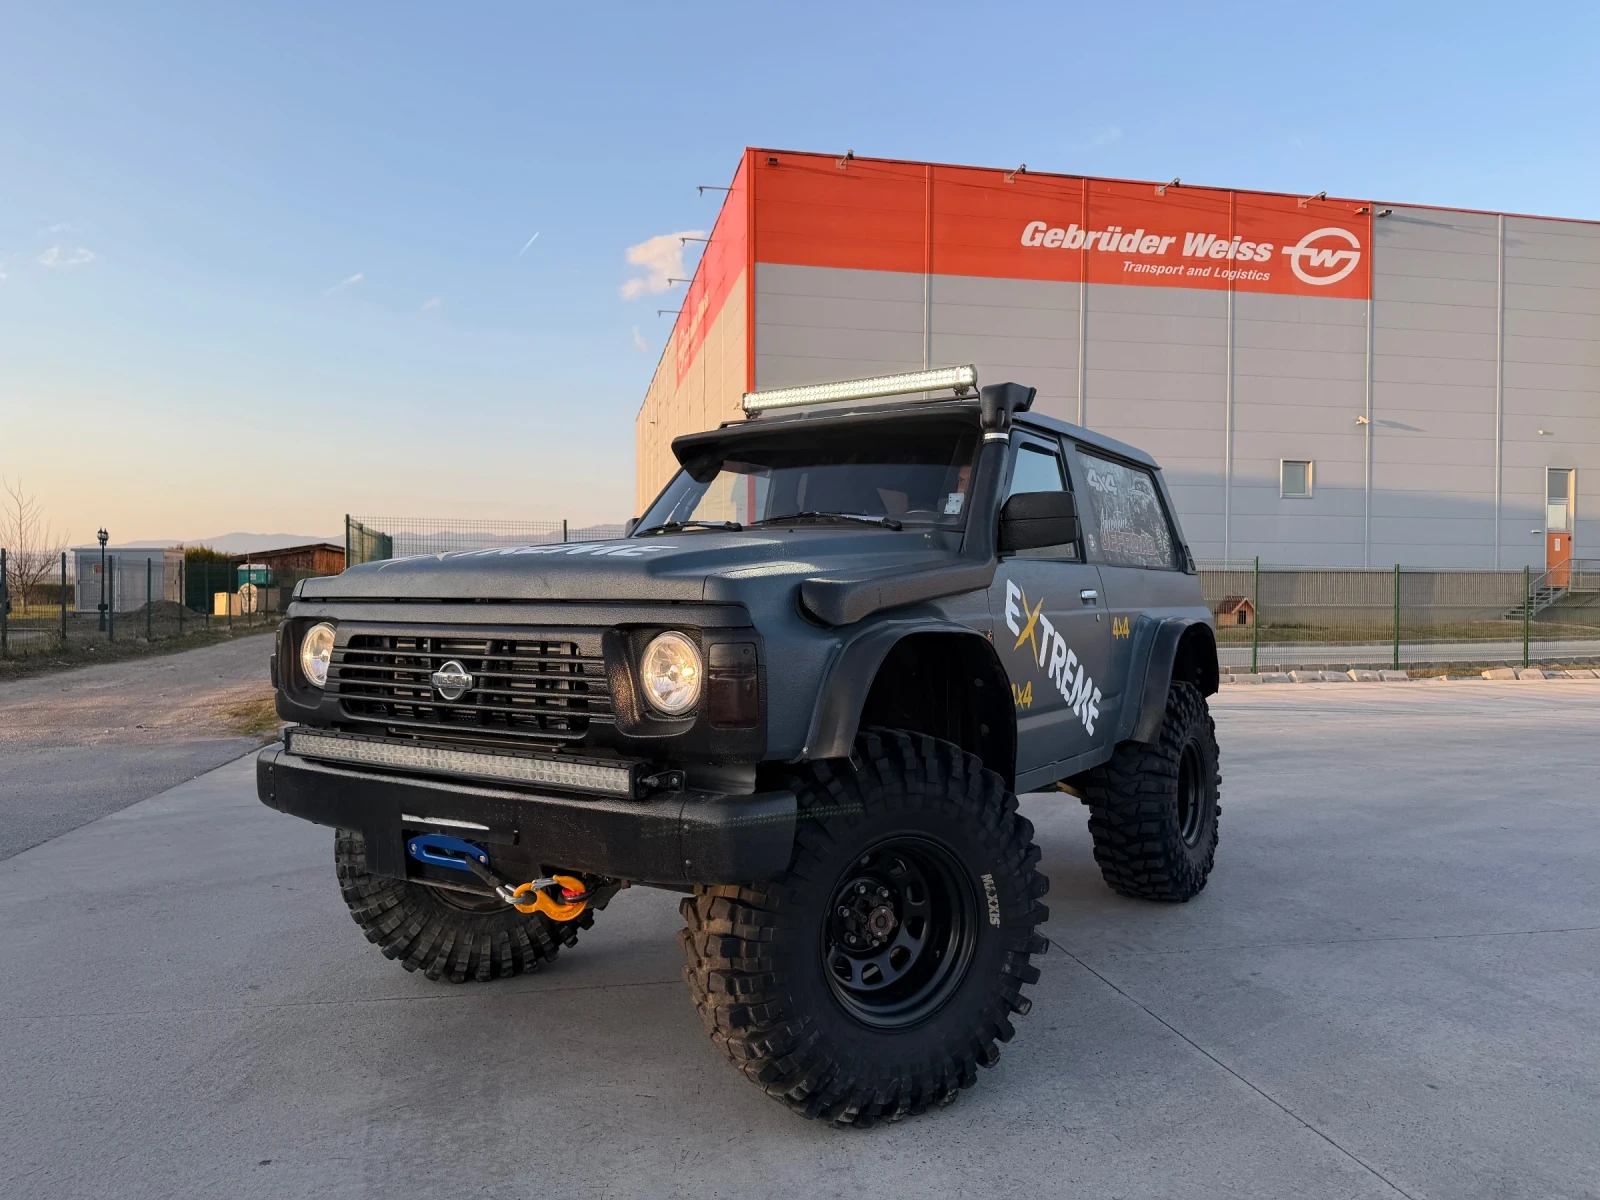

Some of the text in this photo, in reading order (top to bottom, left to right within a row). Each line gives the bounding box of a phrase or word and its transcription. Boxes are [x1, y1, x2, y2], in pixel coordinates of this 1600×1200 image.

[1020, 220, 1274, 262] Gebrüder Weiss
[1123, 261, 1271, 281] Transport and Logistics
[1112, 616, 1130, 639] 4x4
[1005, 579, 1102, 736] EXTREME
[981, 874, 1000, 926] MAXXIS
